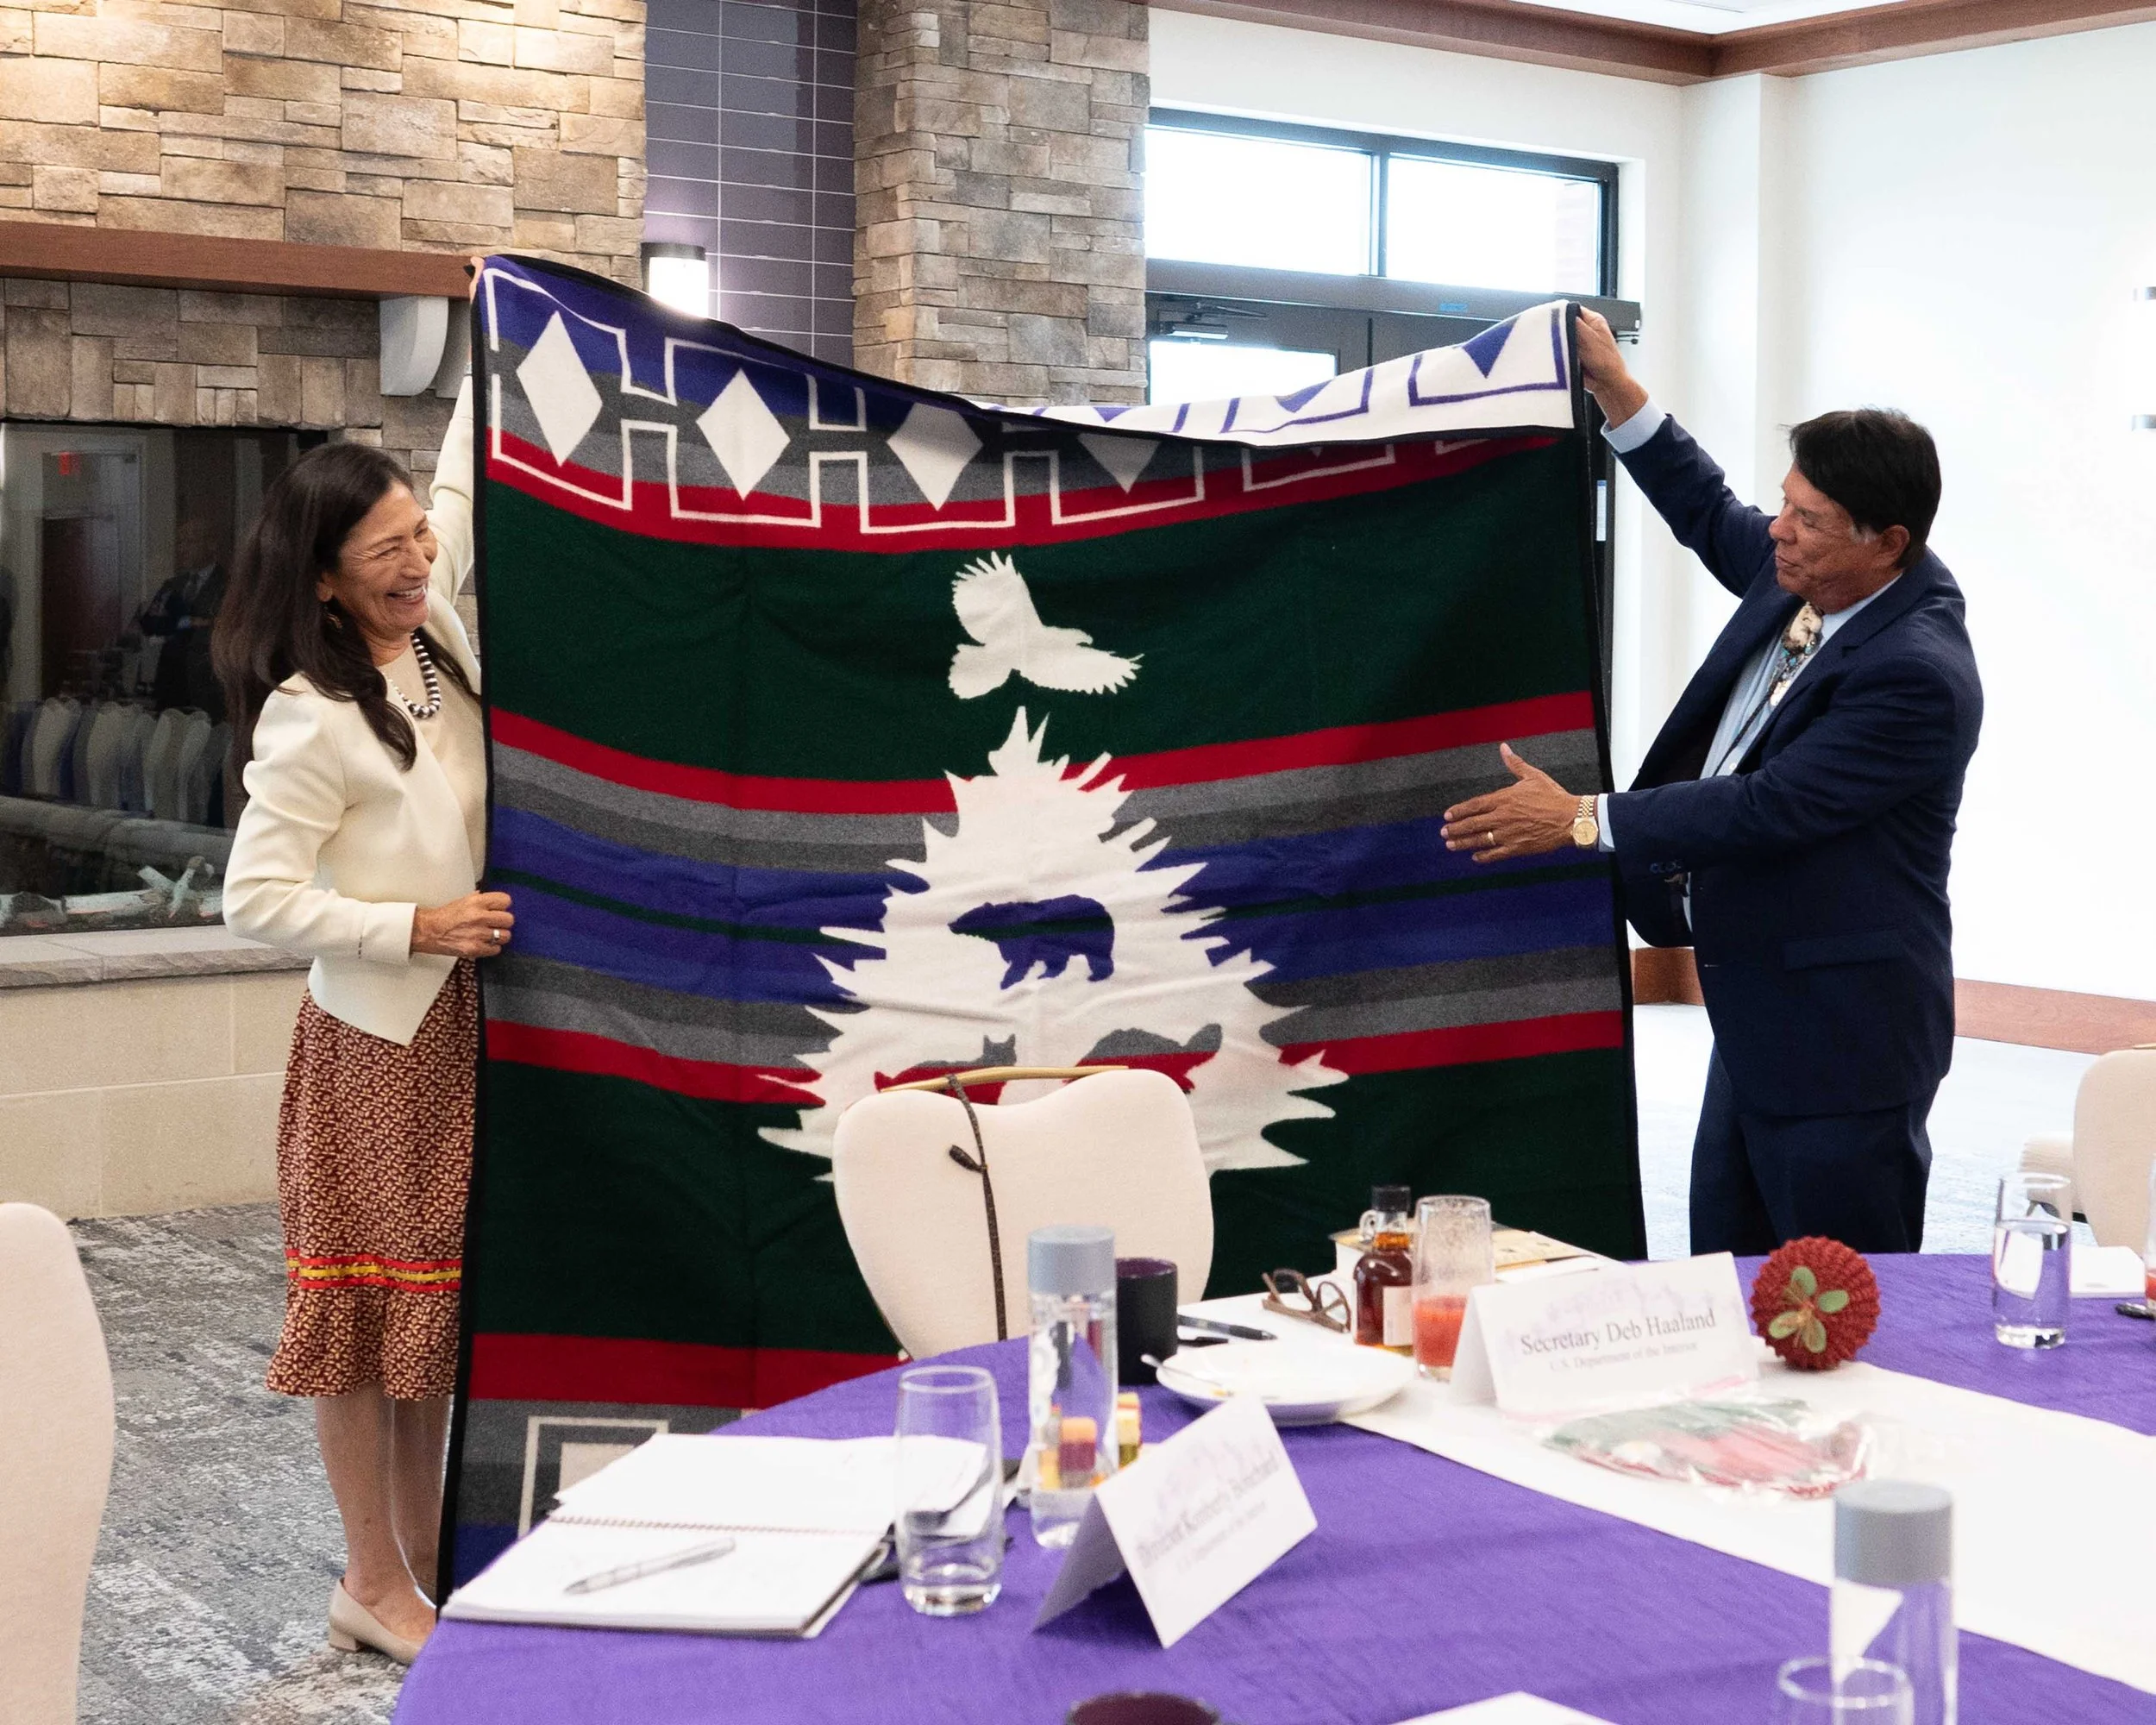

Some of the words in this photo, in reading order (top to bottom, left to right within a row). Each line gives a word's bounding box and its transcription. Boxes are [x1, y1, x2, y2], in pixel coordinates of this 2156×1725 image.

[1520, 1330, 1601, 1355] Secretary
[1606, 1320, 1642, 1342] Deb
[1646, 1308, 1716, 1336] Haaland
